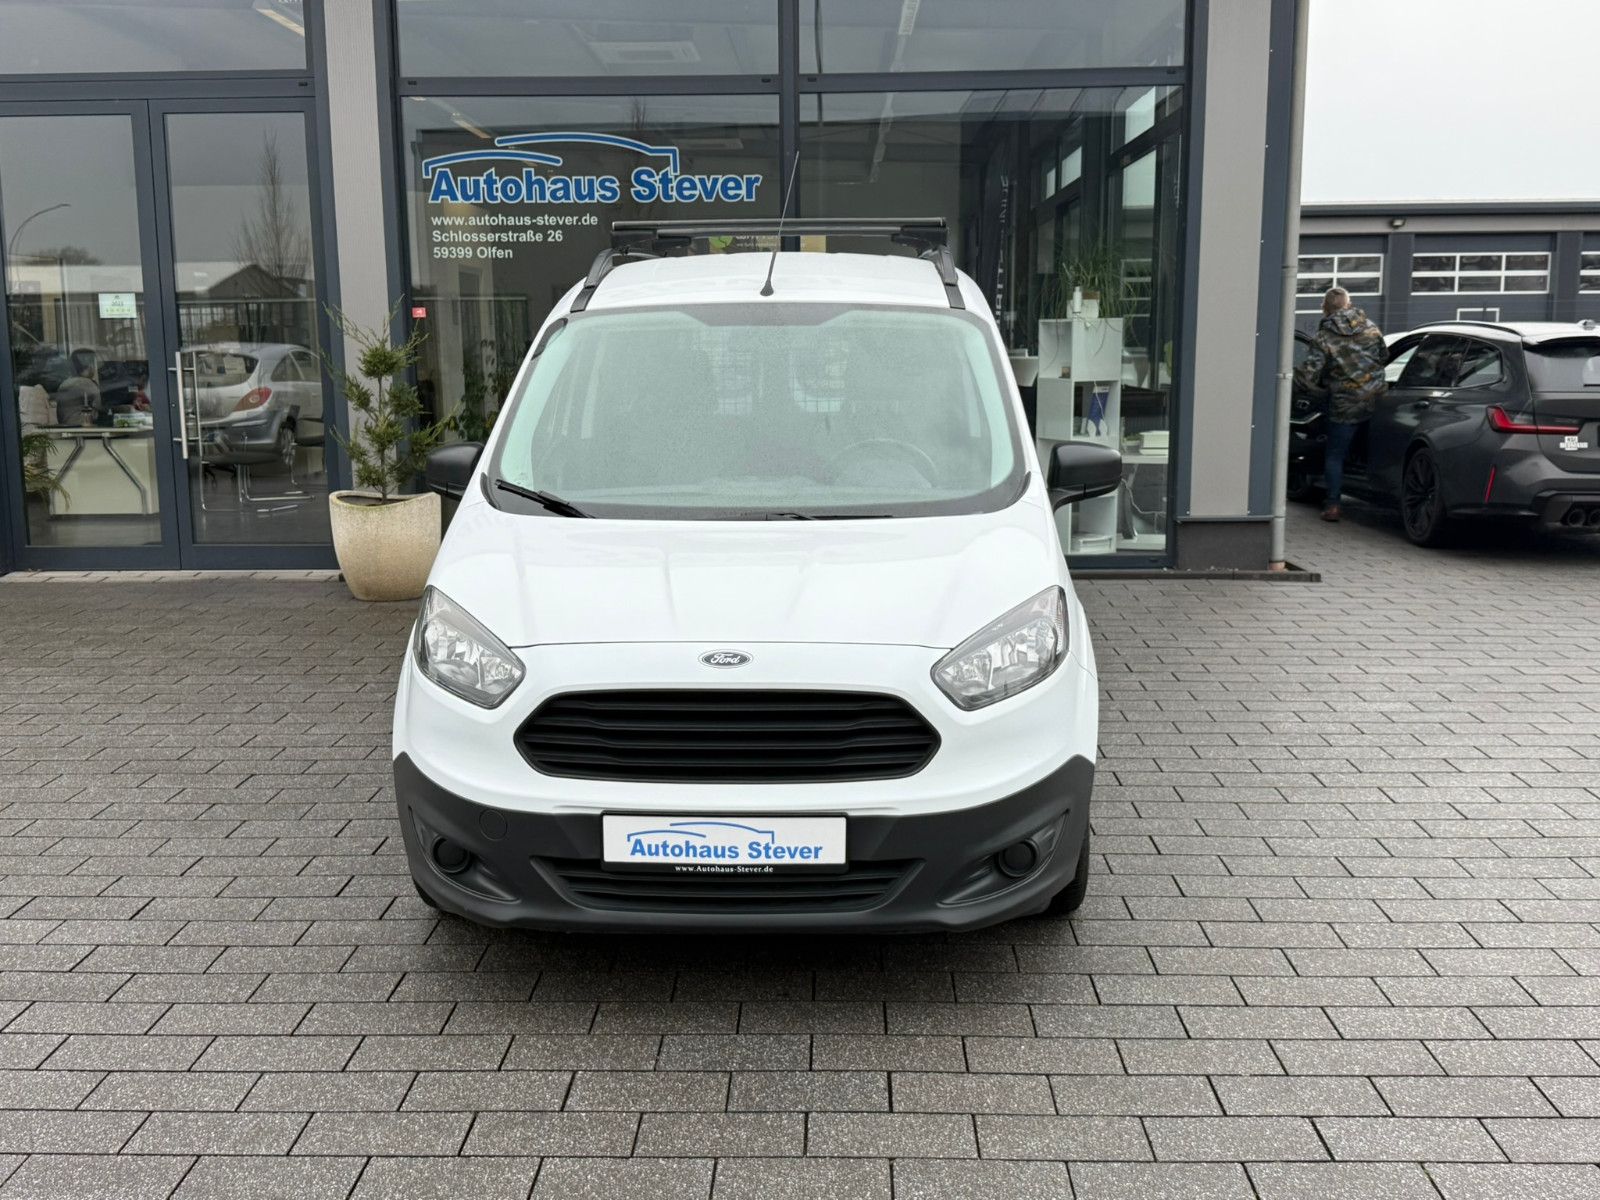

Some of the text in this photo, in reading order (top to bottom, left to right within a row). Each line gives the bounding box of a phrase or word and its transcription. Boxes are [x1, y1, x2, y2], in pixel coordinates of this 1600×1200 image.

[428, 166, 763, 204] Autohaus Stever
[430, 213, 599, 227] www.autohaus-stever.de
[431, 229, 564, 243] Schlosserstraße 26
[432, 246, 514, 260] 59399 Olfen
[709, 652, 741, 664] Ford
[629, 838, 823, 860] Autohaus Stever
[674, 864, 774, 874] www.Autohaus-Stever.de
